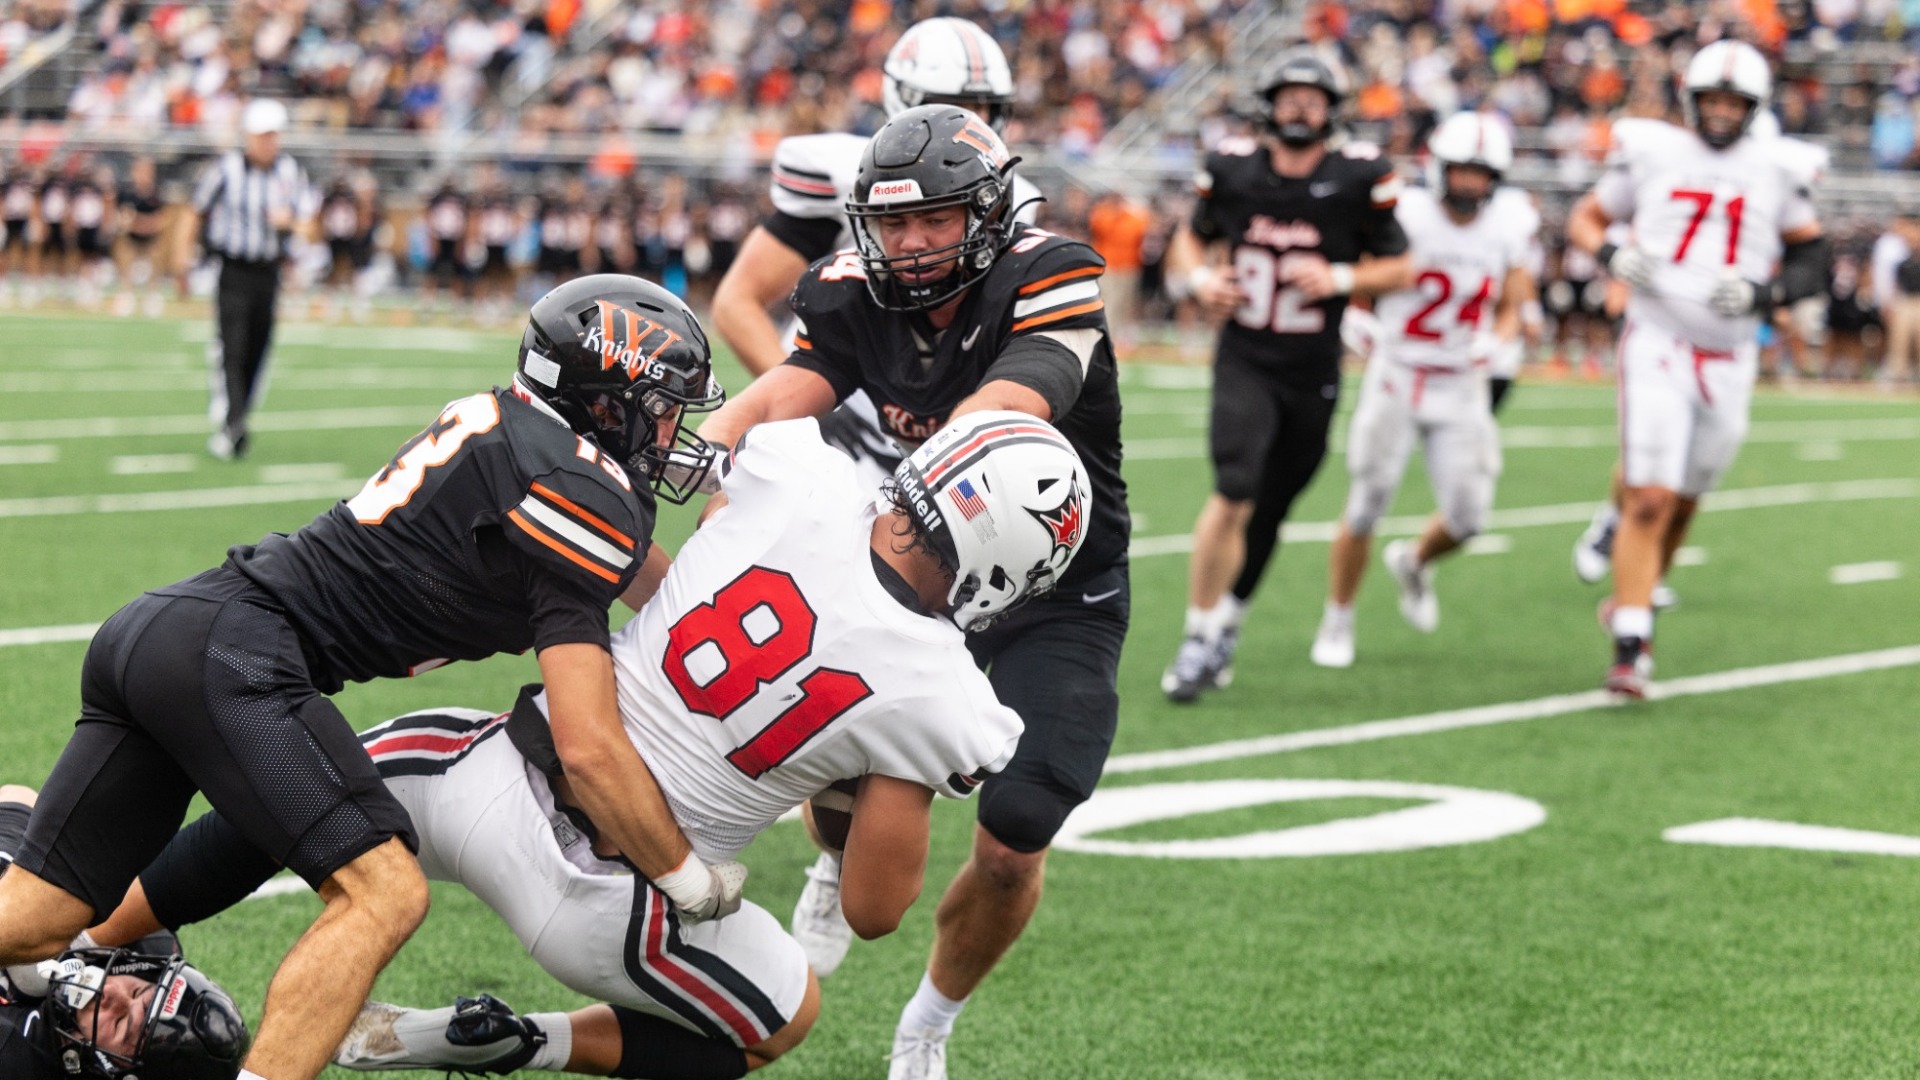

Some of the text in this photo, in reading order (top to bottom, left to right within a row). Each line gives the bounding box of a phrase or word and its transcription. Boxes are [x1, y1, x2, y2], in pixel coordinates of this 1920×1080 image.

[873, 182, 912, 196] Riddell
[1671, 189, 1744, 265] 71
[1235, 246, 1326, 334] 92
[1404, 270, 1493, 341] 24
[581, 326, 666, 380] Knights
[895, 461, 942, 533] Riddell
[661, 564, 875, 781] 81
[163, 978, 185, 1014] Riddell
